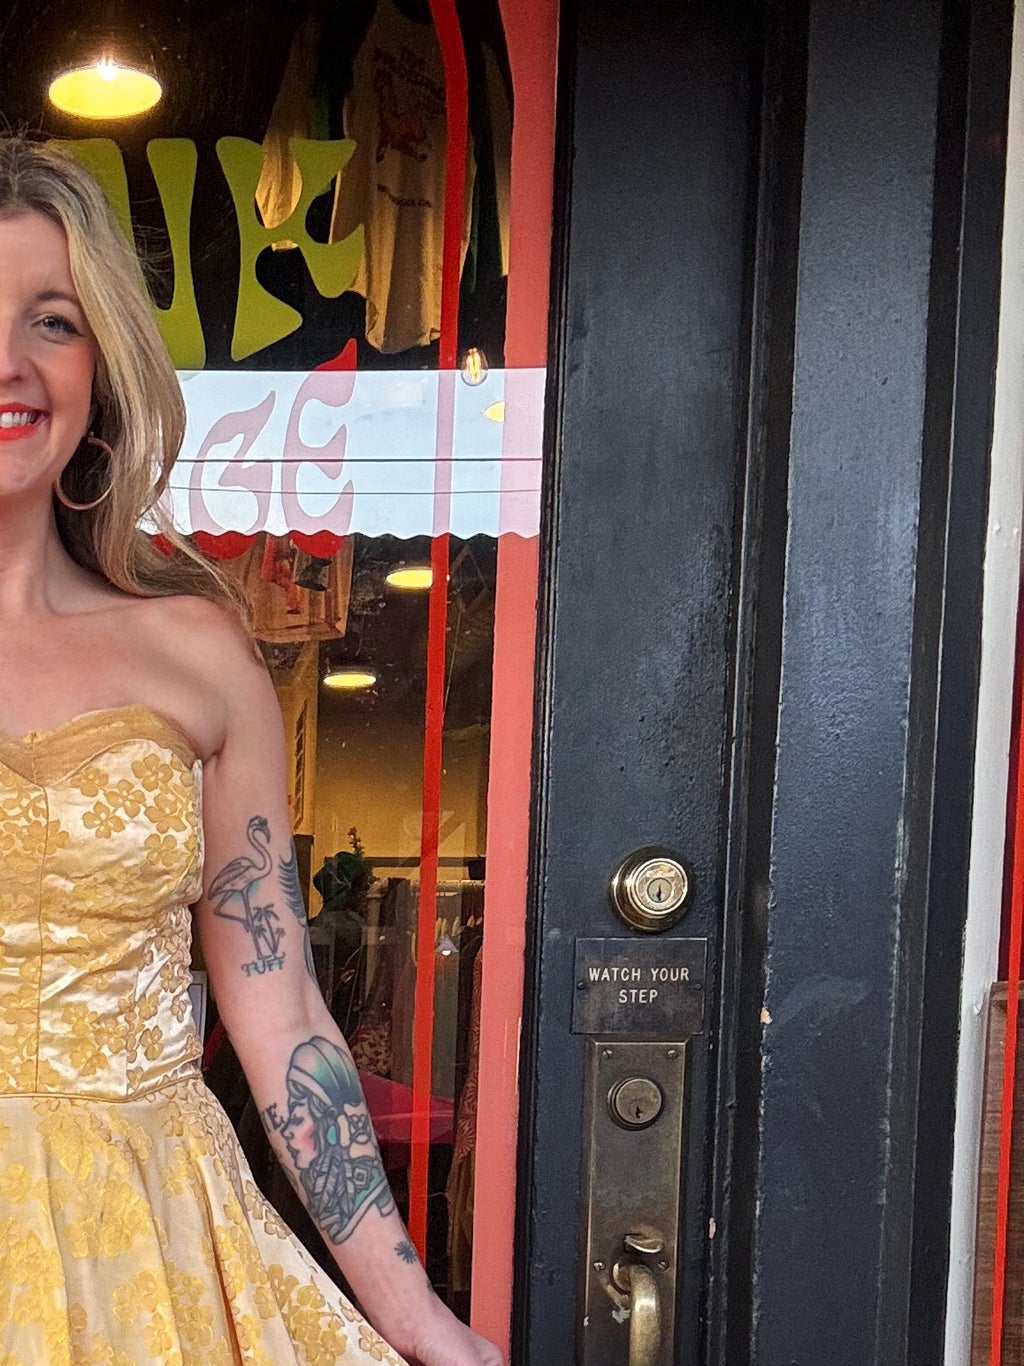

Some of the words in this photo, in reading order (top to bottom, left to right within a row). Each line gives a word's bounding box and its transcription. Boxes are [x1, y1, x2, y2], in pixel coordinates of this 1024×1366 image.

[588, 967, 641, 981] WATCH
[650, 967, 690, 982] YOUR
[618, 989, 659, 1004] STEP
